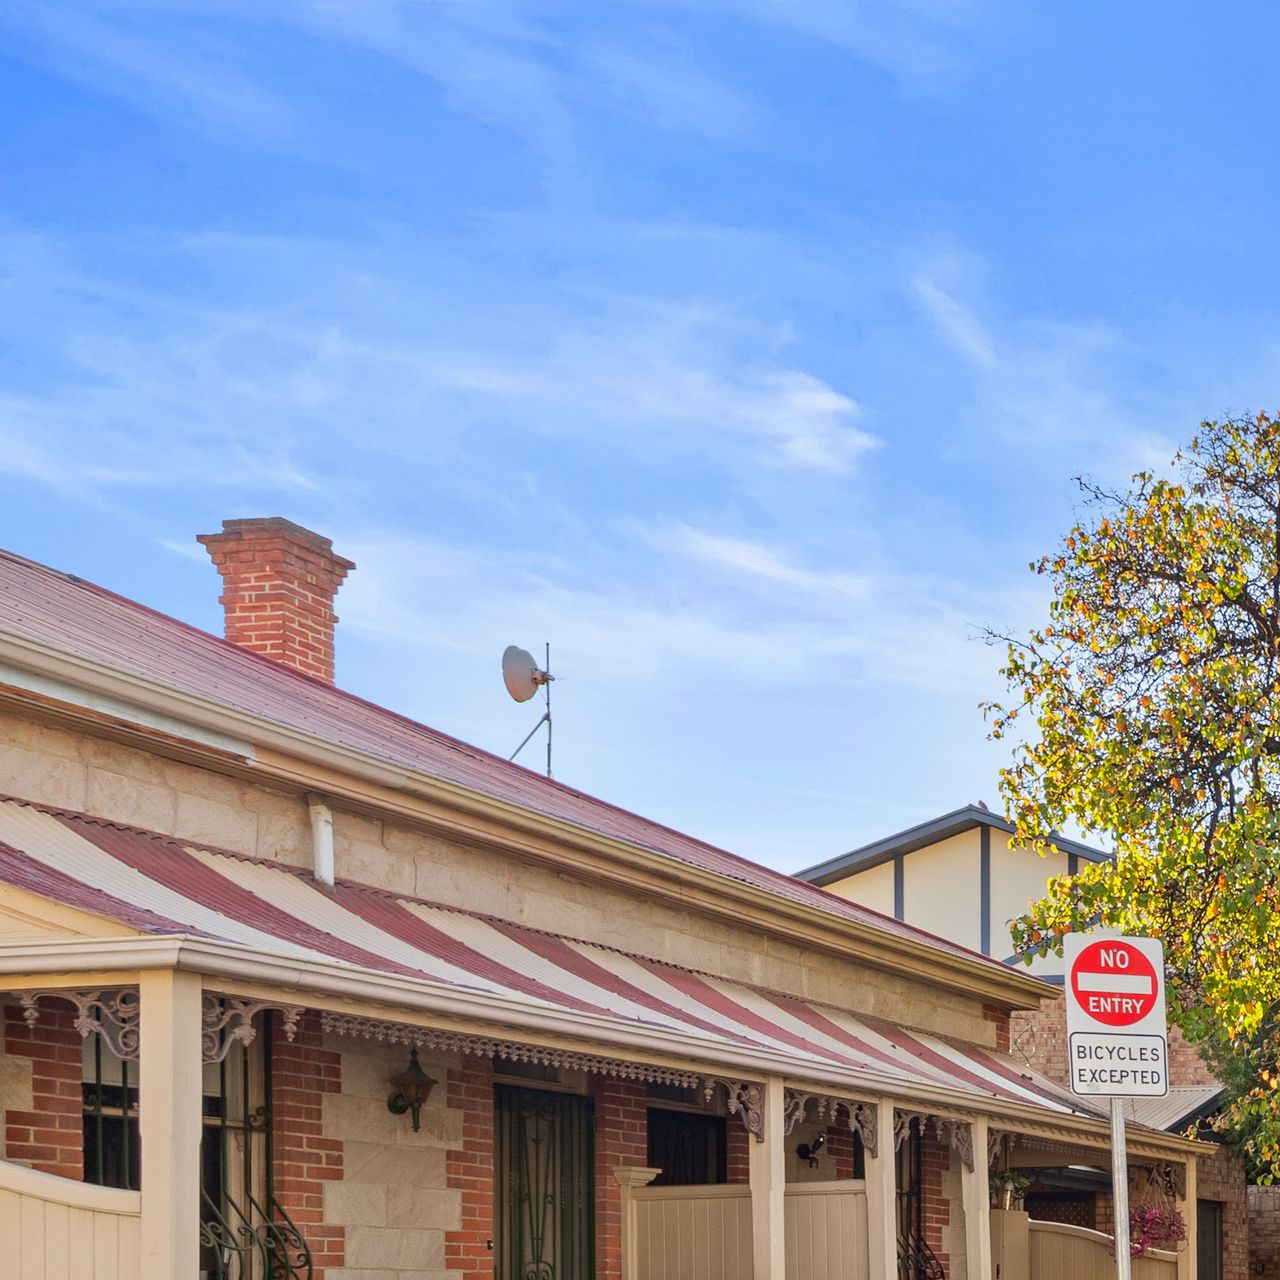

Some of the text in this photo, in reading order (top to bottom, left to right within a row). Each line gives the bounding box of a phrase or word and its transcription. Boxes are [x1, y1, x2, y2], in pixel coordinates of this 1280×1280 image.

[1100, 948, 1130, 969] NO
[1089, 996, 1145, 1015] ENTRY
[1076, 1045, 1160, 1062] BICYCLES
[1078, 1068, 1161, 1085] EXCEPTED
